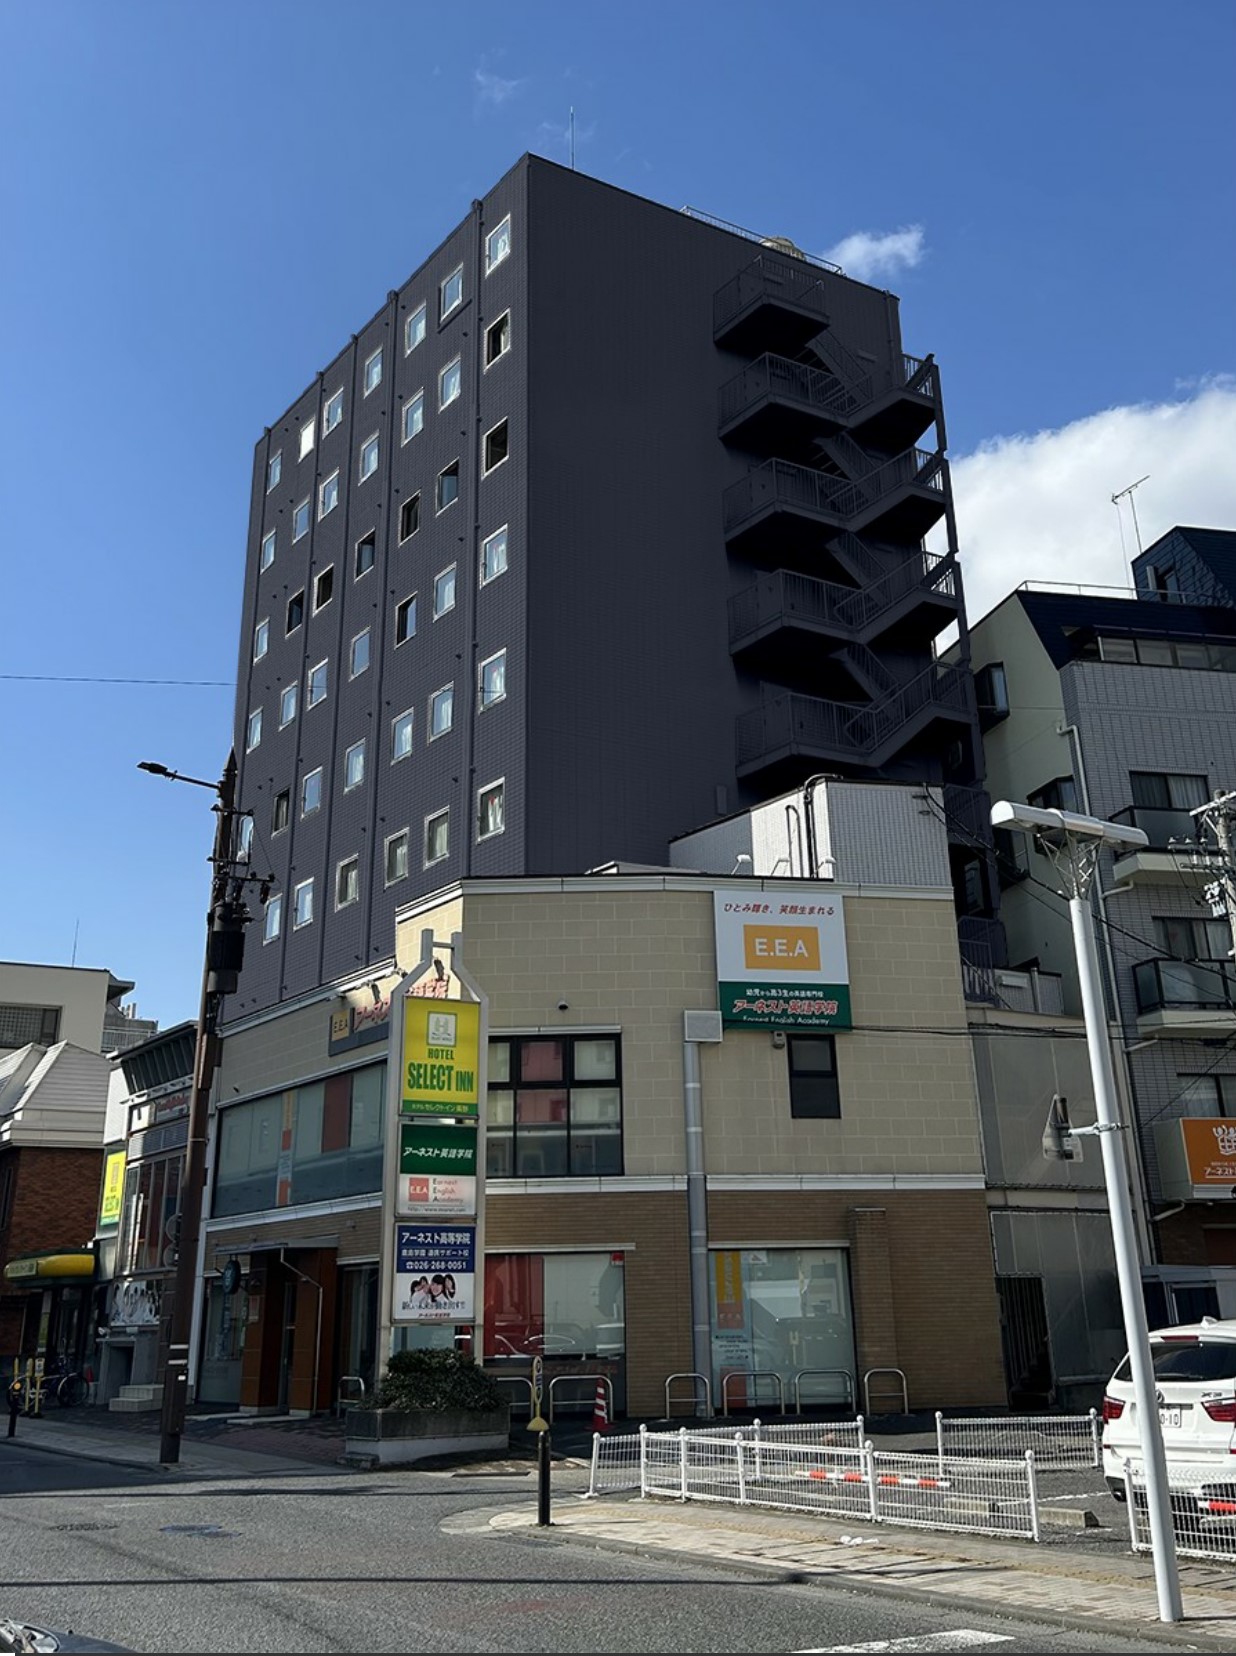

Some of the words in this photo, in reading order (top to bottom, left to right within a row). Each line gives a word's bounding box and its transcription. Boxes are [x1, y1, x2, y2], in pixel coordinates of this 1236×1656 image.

[724, 903, 834, 915] ひとみ輝き、笑顔生まれる
[755, 938, 808, 957] E.E.A
[428, 1049, 454, 1060] HOTEL
[408, 1062, 454, 1091] SELECT
[455, 1070, 474, 1092] INN
[403, 1147, 473, 1158] アーネスト英語学院
[402, 1232, 470, 1245] アーネスト高等学院
